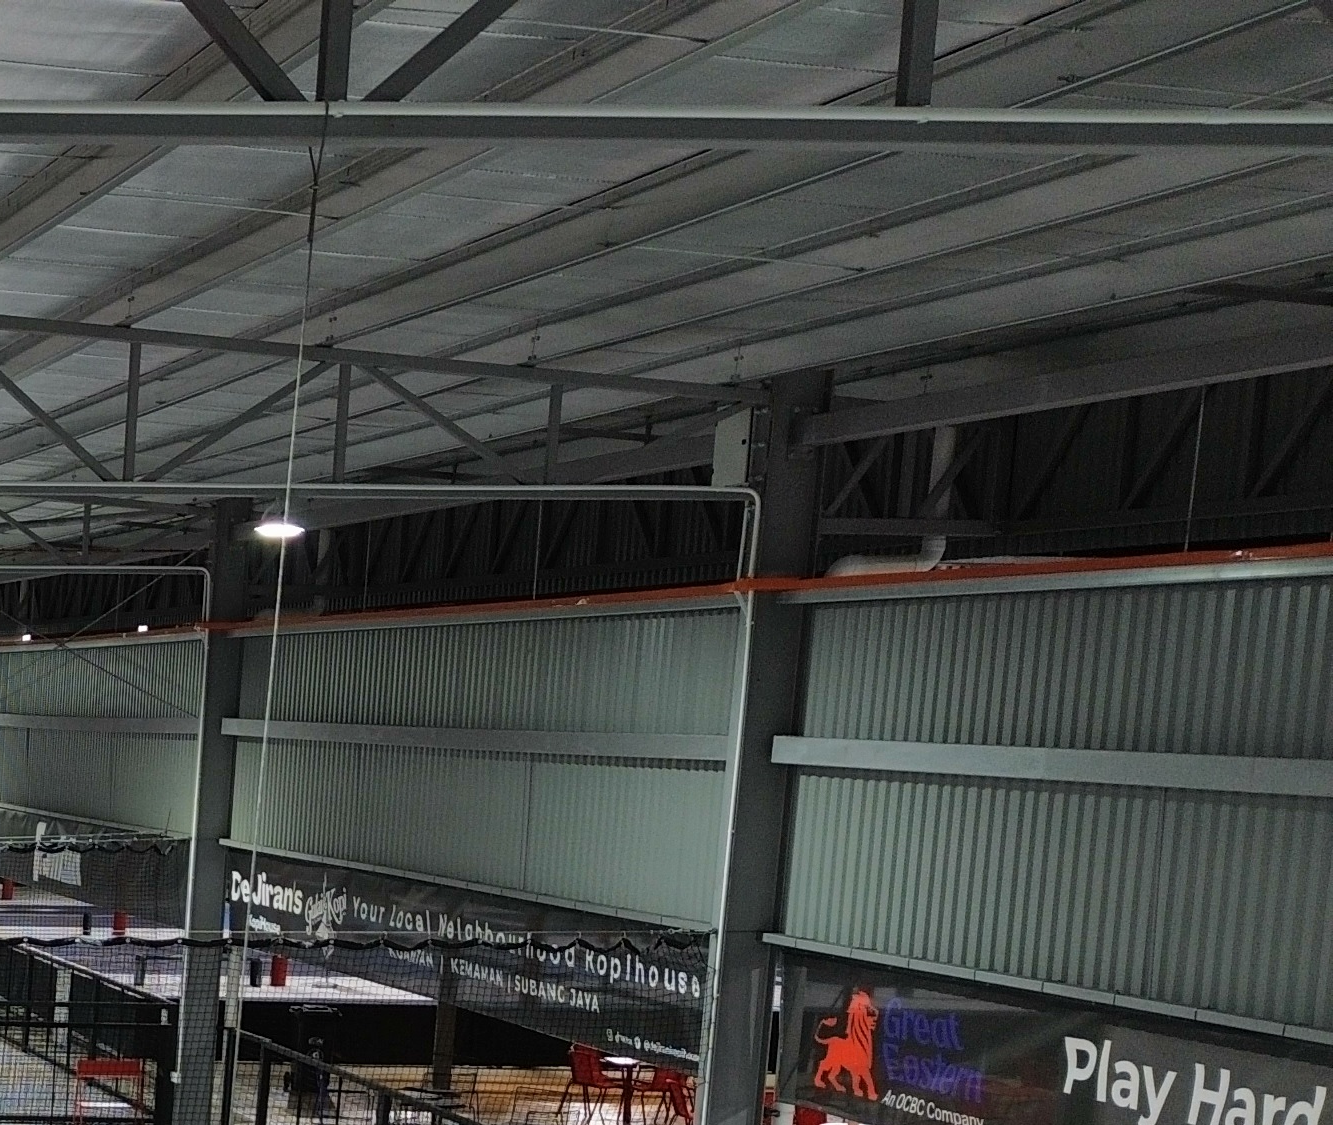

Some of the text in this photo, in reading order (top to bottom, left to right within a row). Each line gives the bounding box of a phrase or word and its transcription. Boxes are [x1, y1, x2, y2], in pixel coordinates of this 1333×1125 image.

[252, 871, 303, 915] Jiran's
[353, 895, 385, 924] Your
[390, 904, 431, 935] Local
[450, 959, 503, 987] KEMAMAN
[514, 975, 565, 1004] SUBANG
[569, 990, 601, 1014] JAYA
[883, 997, 964, 1051] Great
[883, 1042, 983, 1104] Eastern
[881, 1089, 896, 1107] An
[896, 1093, 925, 1116] OCBC
